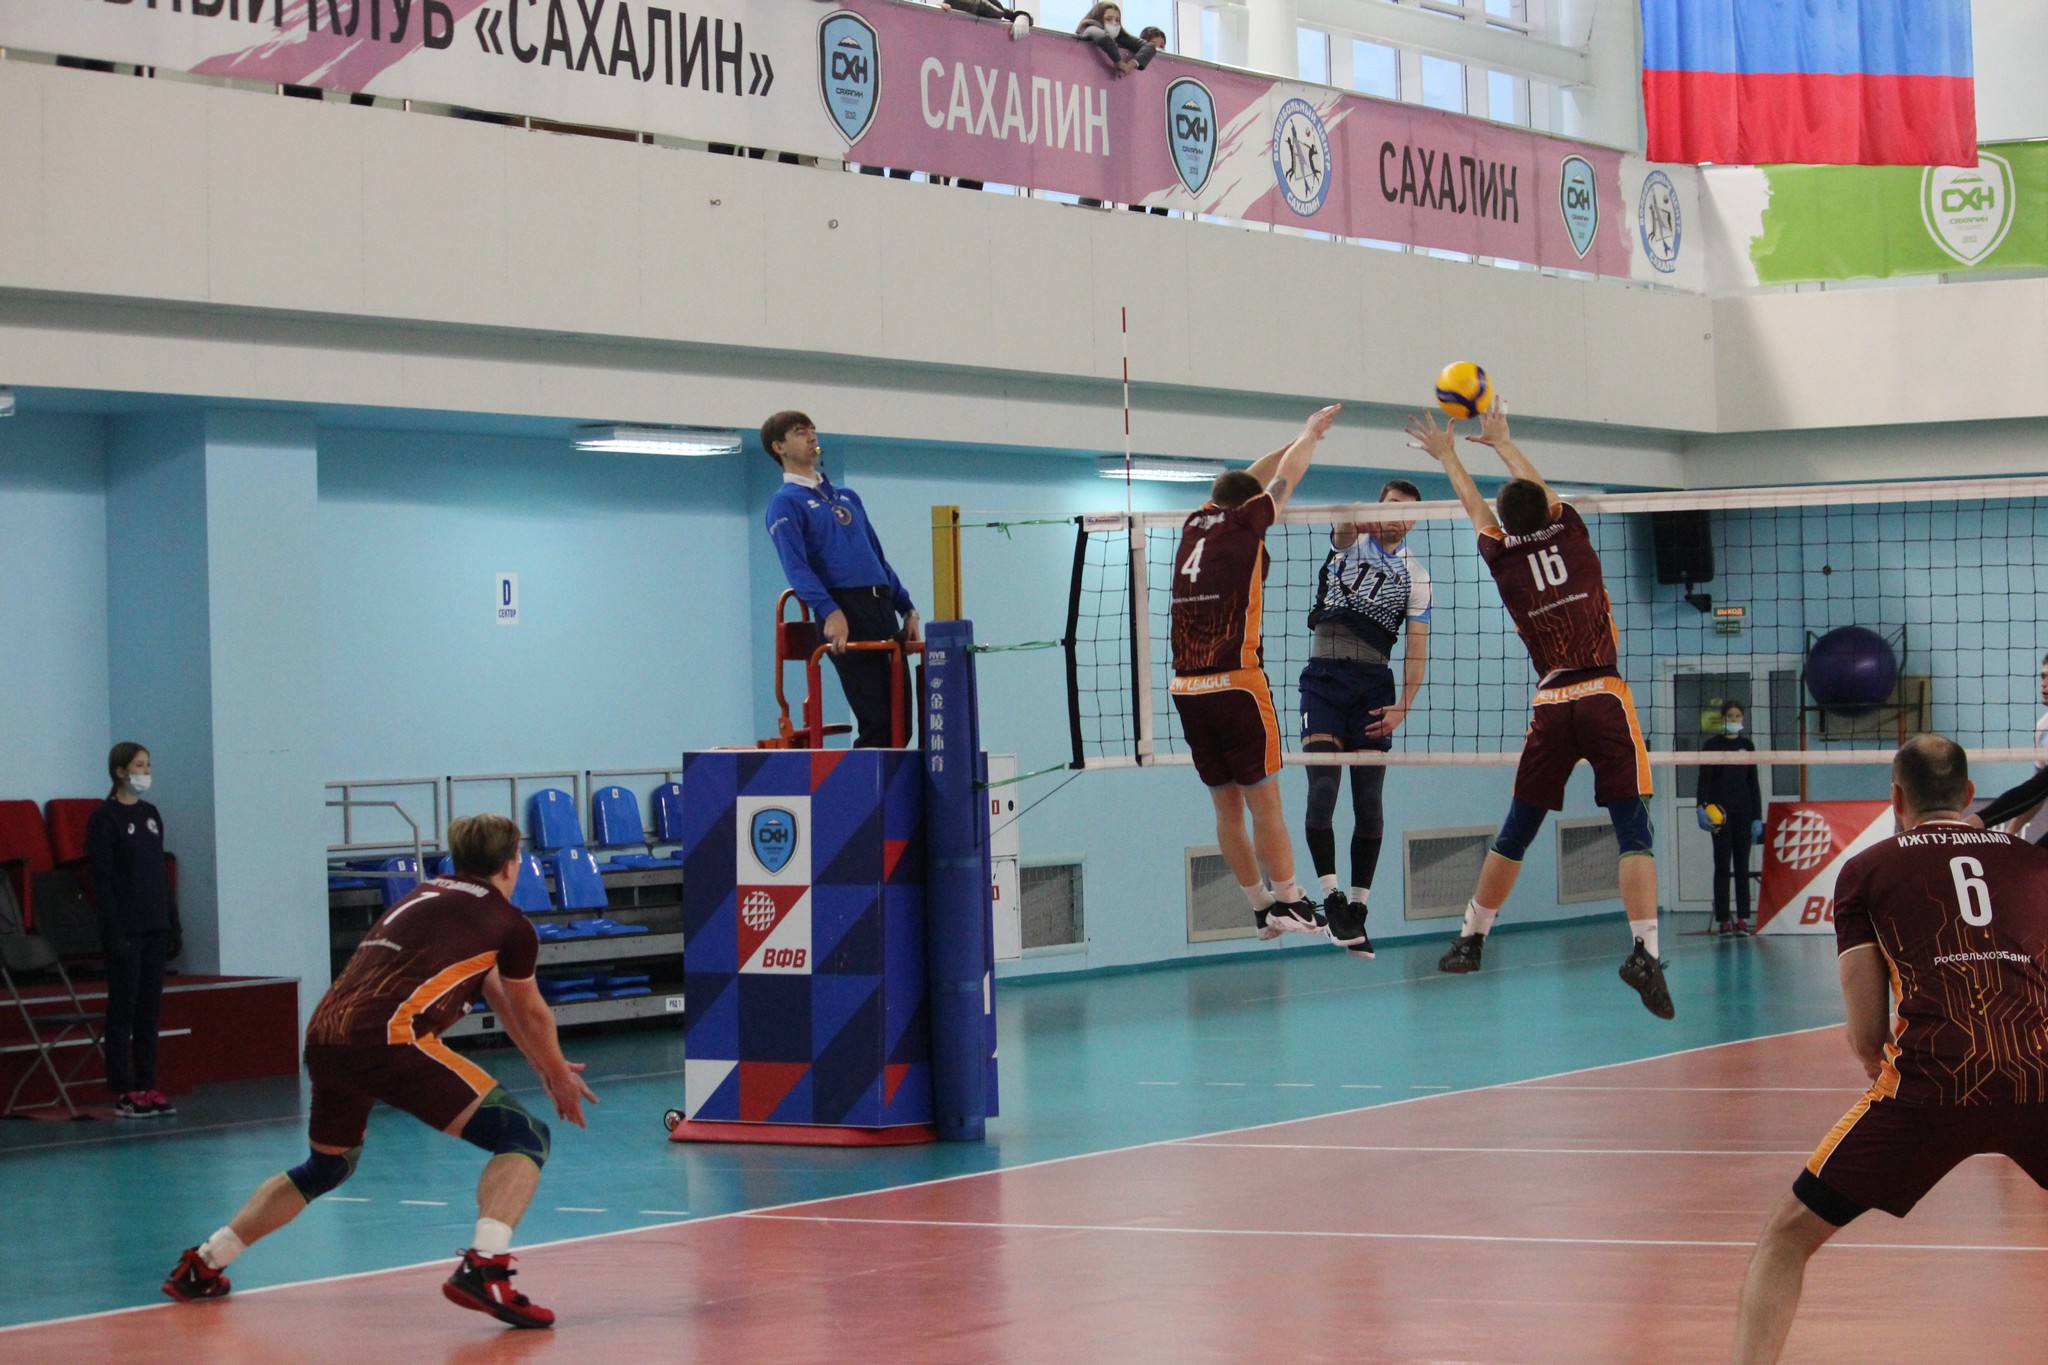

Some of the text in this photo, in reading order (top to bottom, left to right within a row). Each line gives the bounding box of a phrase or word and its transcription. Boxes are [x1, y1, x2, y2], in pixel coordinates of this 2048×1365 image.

[475, 0, 774, 97] «САХАЛИН»
[921, 57, 1109, 156] САХАЛИН
[1273, 101, 1331, 171] ВОЛЕЙБОЛЬНЫЙ ЦЕНТР
[1286, 192, 1320, 214] САХАЛИН
[1380, 141, 1518, 223] САХАЛИН
[1181, 538, 1205, 583] 4
[1350, 562, 1388, 603] 11
[1527, 545, 1568, 591] 16
[502, 579, 512, 606] D
[930, 693, 944, 773] 金陵体育
[1897, 832, 2012, 847] ИЖГТУ-ДИНАМО
[1949, 856, 1993, 927] 6
[762, 948, 806, 968] ВФВ
[1934, 950, 2031, 966] РоссельхозБанк
